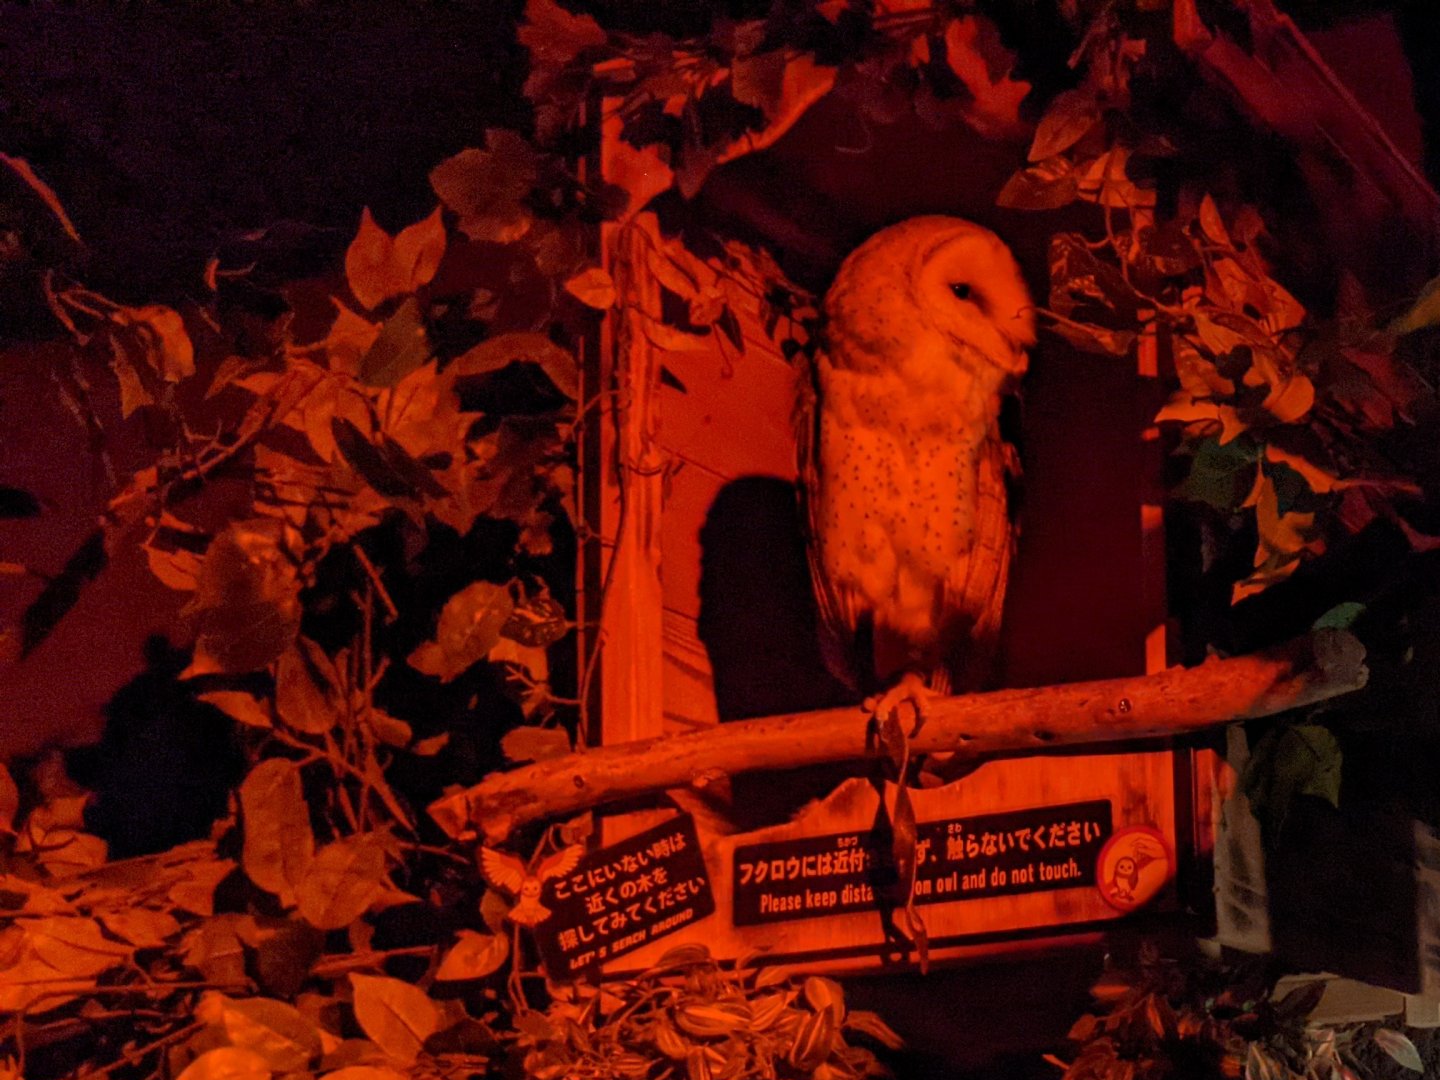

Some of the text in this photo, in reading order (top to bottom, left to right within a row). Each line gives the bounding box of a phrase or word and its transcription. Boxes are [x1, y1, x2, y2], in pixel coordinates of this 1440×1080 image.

[555, 832, 687, 899] ここにいない時は
[585, 867, 668, 915] 近くの木を
[760, 892, 802, 914] Please
[806, 888, 838, 908] keep
[841, 884, 874, 905] dista
[961, 868, 987, 890] and
[990, 866, 1007, 887] do
[1011, 863, 1035, 885] not
[1039, 857, 1083, 881] touch.
[558, 877, 706, 952] 探してみてください
[651, 908, 694, 936] AROUND
